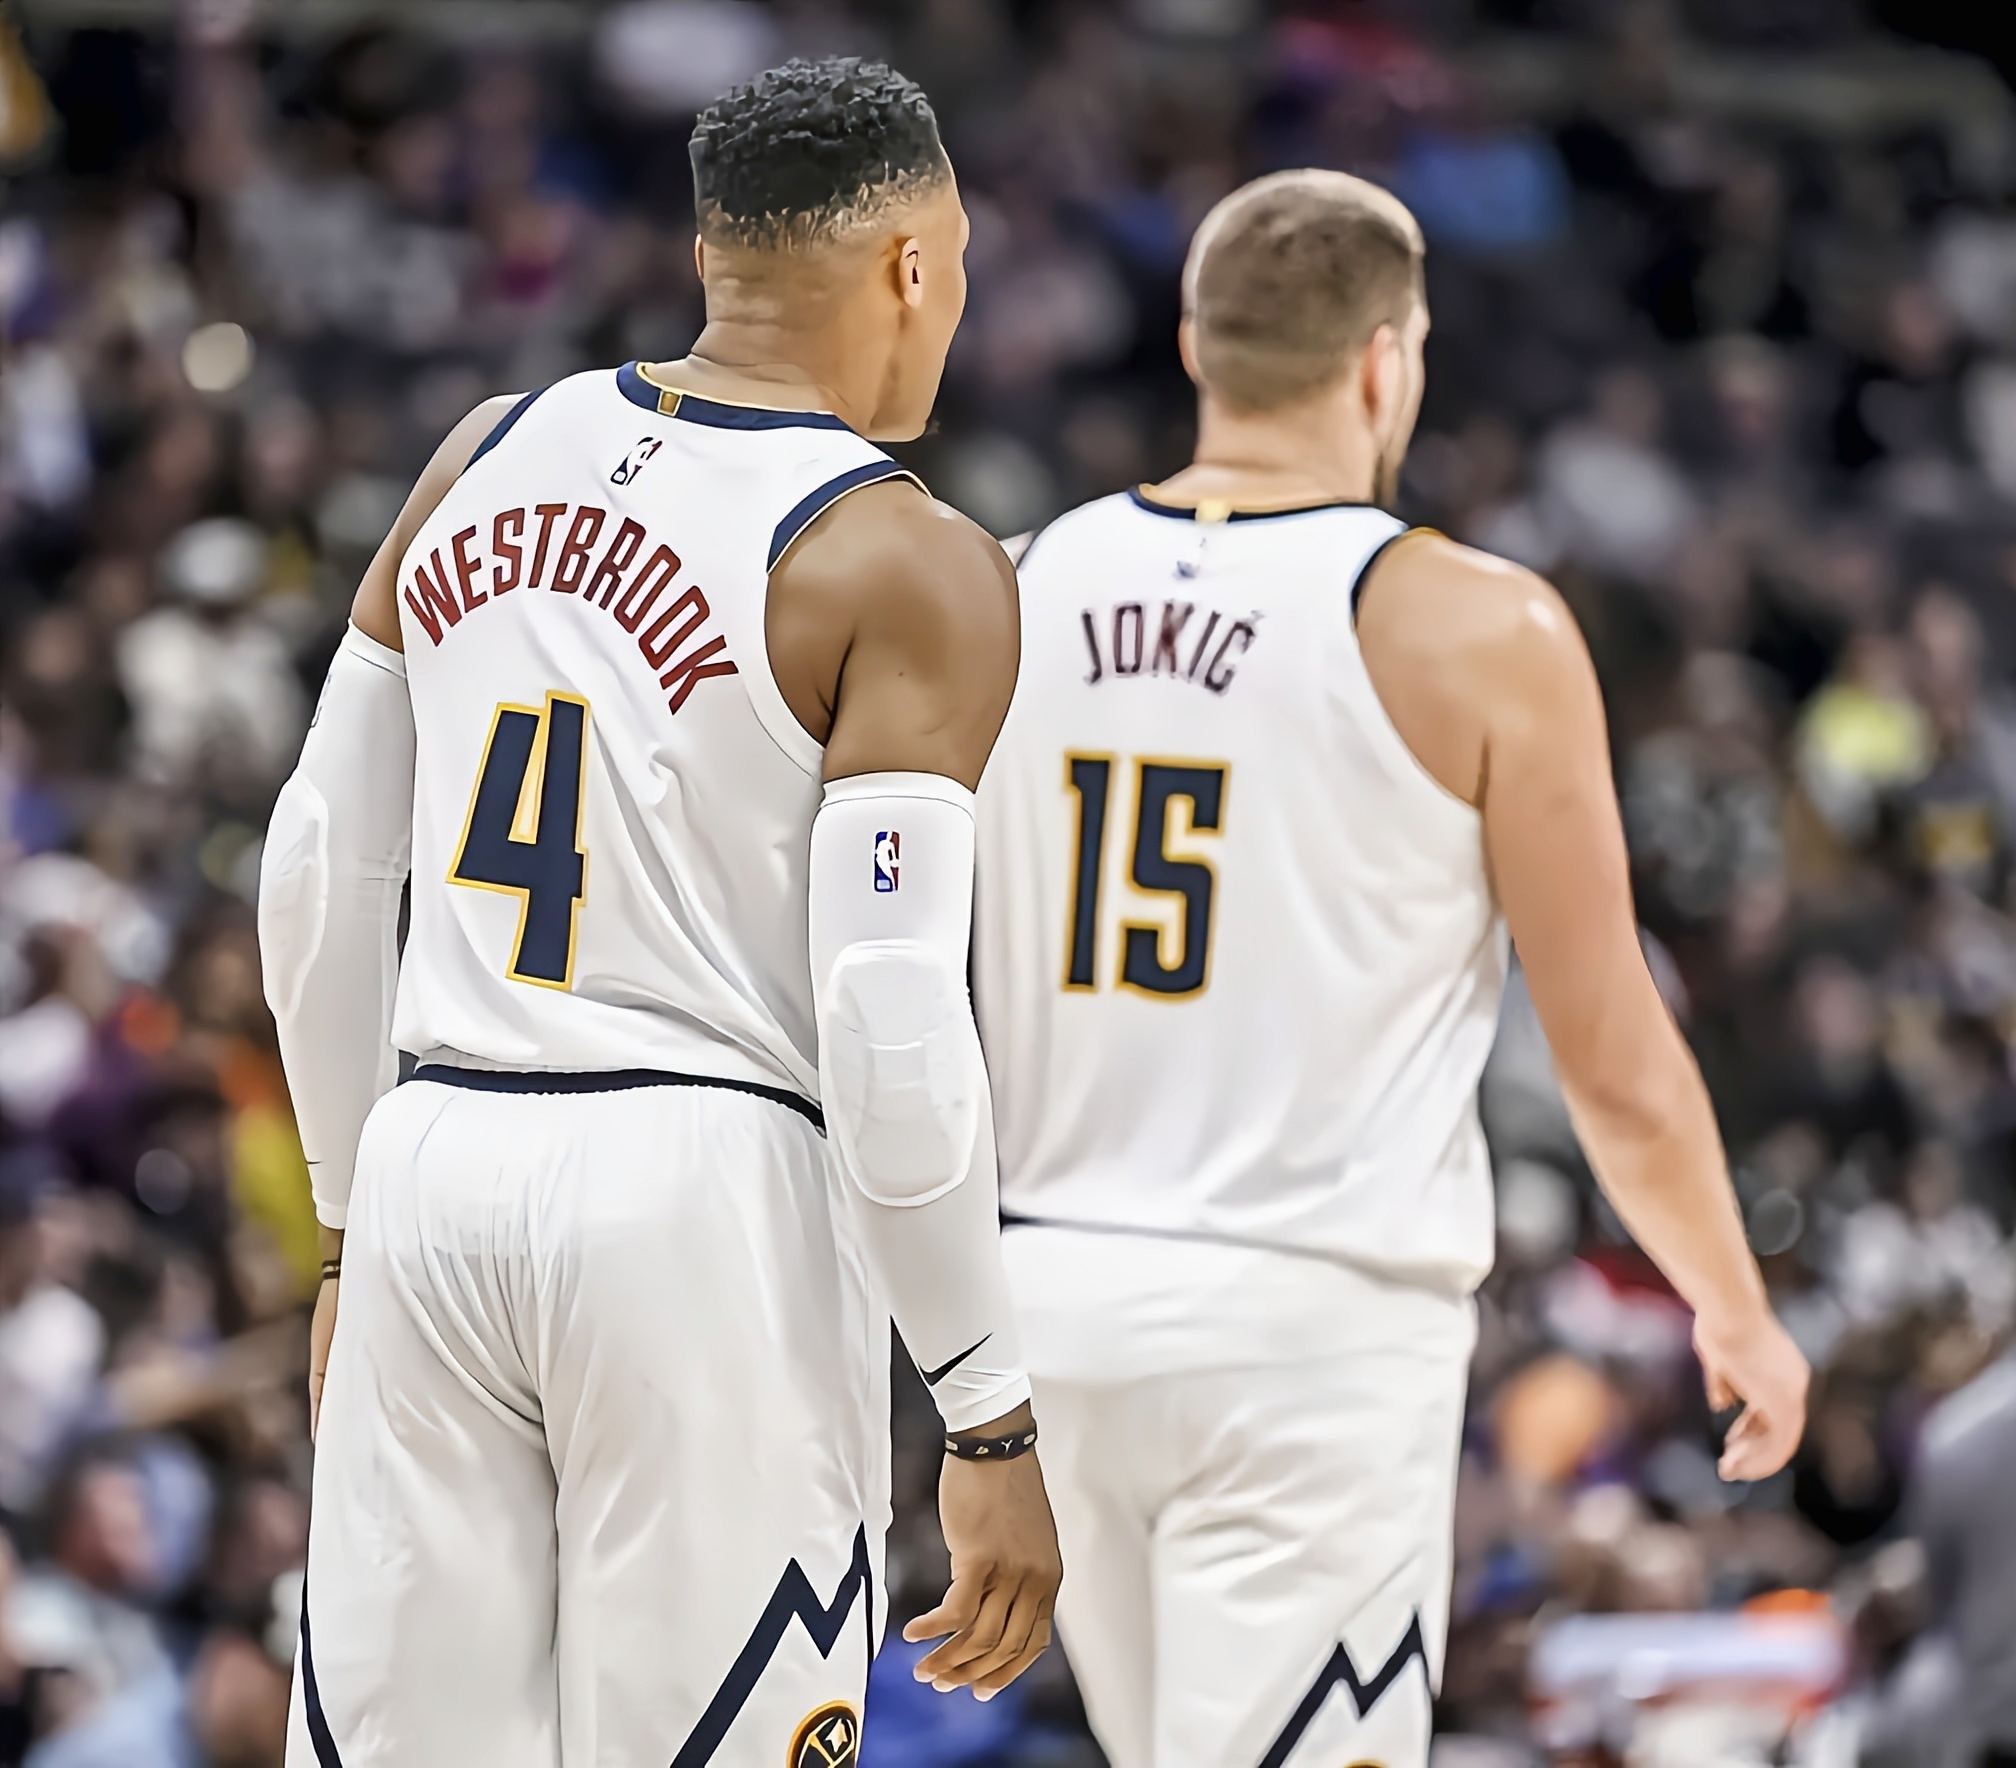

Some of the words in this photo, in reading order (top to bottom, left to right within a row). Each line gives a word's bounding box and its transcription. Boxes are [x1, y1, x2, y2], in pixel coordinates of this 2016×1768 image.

[404, 502, 739, 715] WESTBROOK
[445, 690, 591, 992] 4
[1061, 748, 1231, 1003] 15
